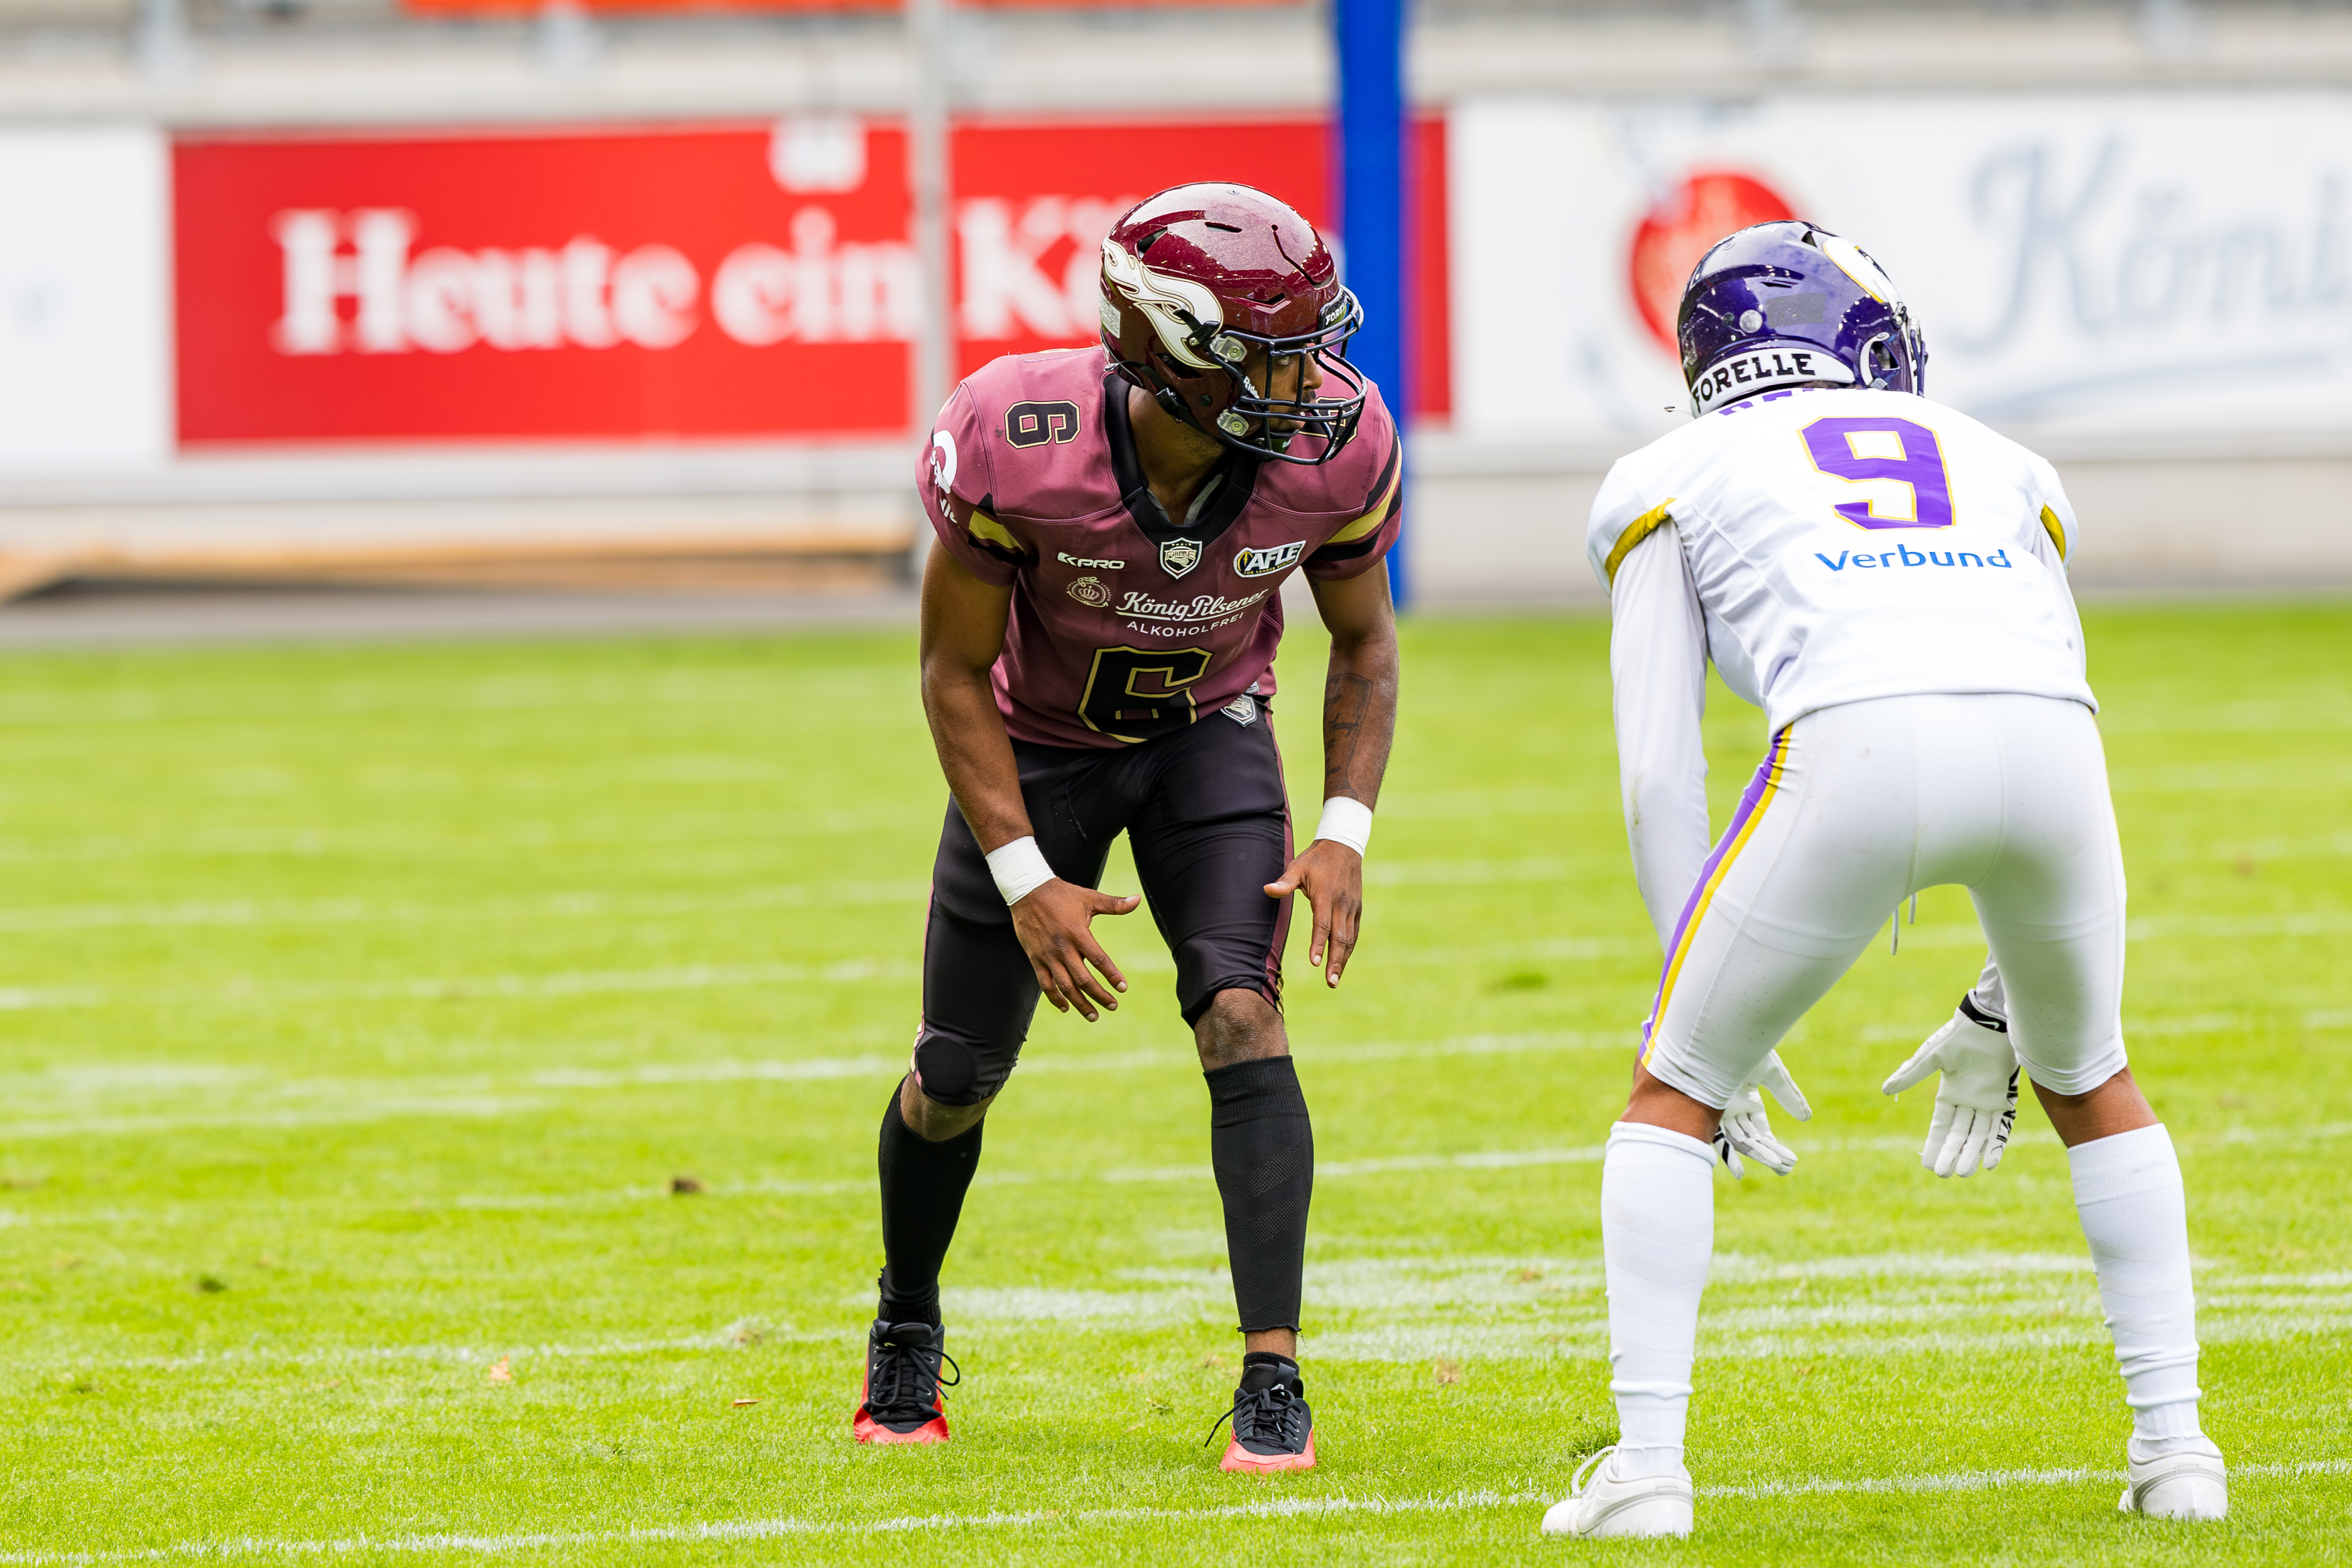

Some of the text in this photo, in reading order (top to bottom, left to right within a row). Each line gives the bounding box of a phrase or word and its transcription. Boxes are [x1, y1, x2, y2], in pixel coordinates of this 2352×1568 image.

[269, 207, 701, 356] Heute
[711, 206, 915, 348] ein
[1692, 353, 1816, 415] FORELLE
[1796, 416, 1956, 531] 9
[1244, 544, 1302, 572] AFLE
[1814, 543, 2012, 572] Verbund
[1115, 592, 1189, 621] König
[1187, 588, 1269, 617] Pilsener
[1127, 612, 1244, 637] ALKOHOLFREI
[1078, 646, 1214, 744] 6
